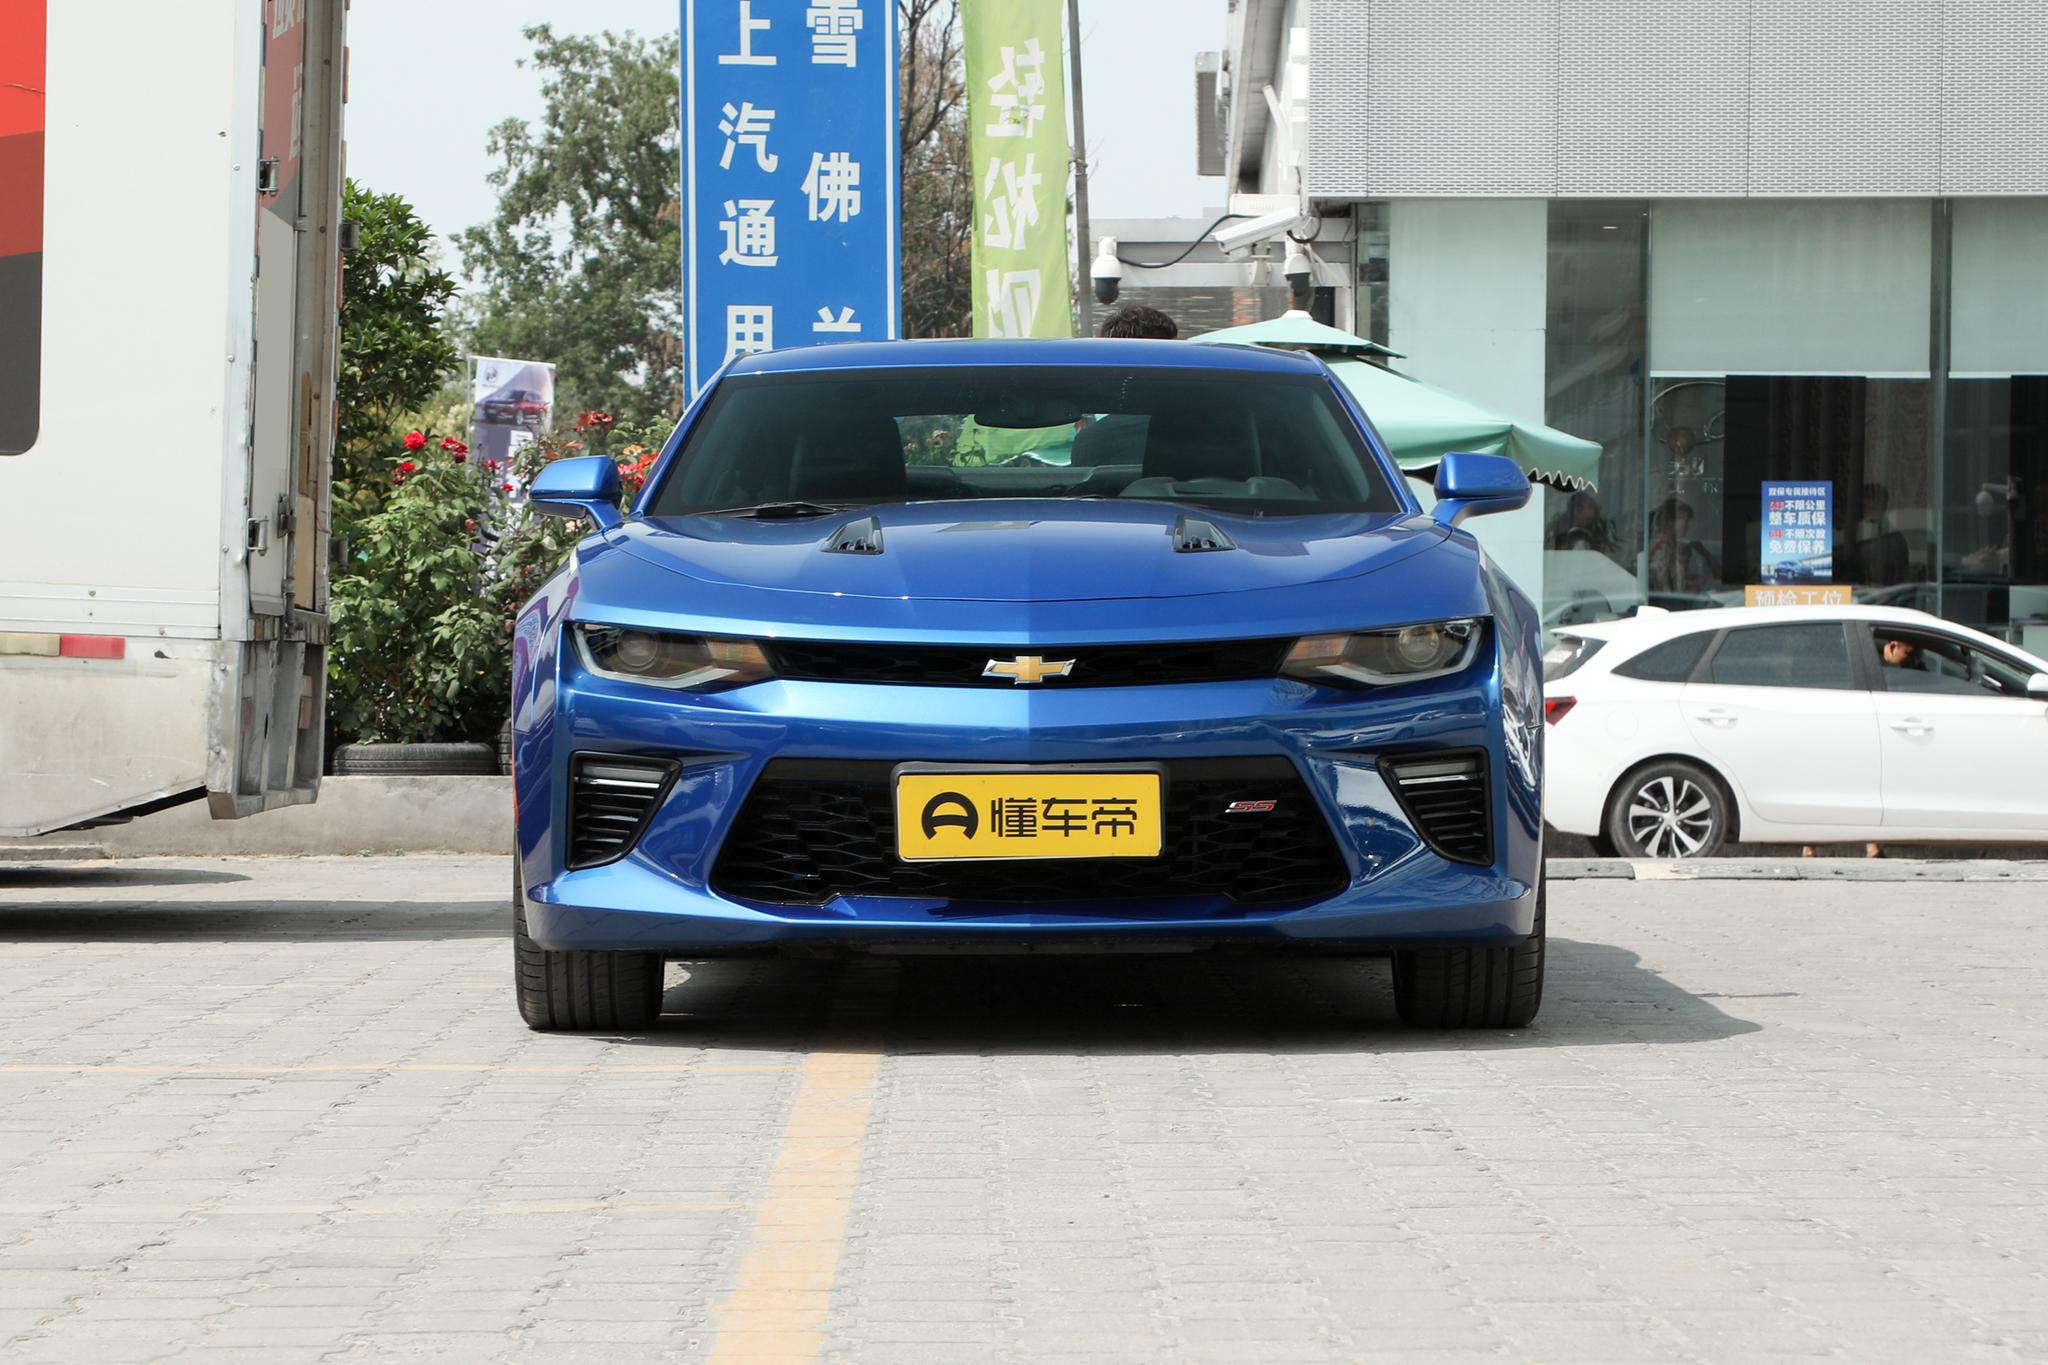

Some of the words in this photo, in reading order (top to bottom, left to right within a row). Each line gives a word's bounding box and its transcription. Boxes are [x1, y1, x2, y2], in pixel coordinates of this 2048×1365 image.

[1768, 511, 1826, 526] 整车质保
[1768, 540, 1826, 554] 免费保养
[1225, 800, 1277, 813] SS
[991, 797, 1137, 837] 懂车帝
